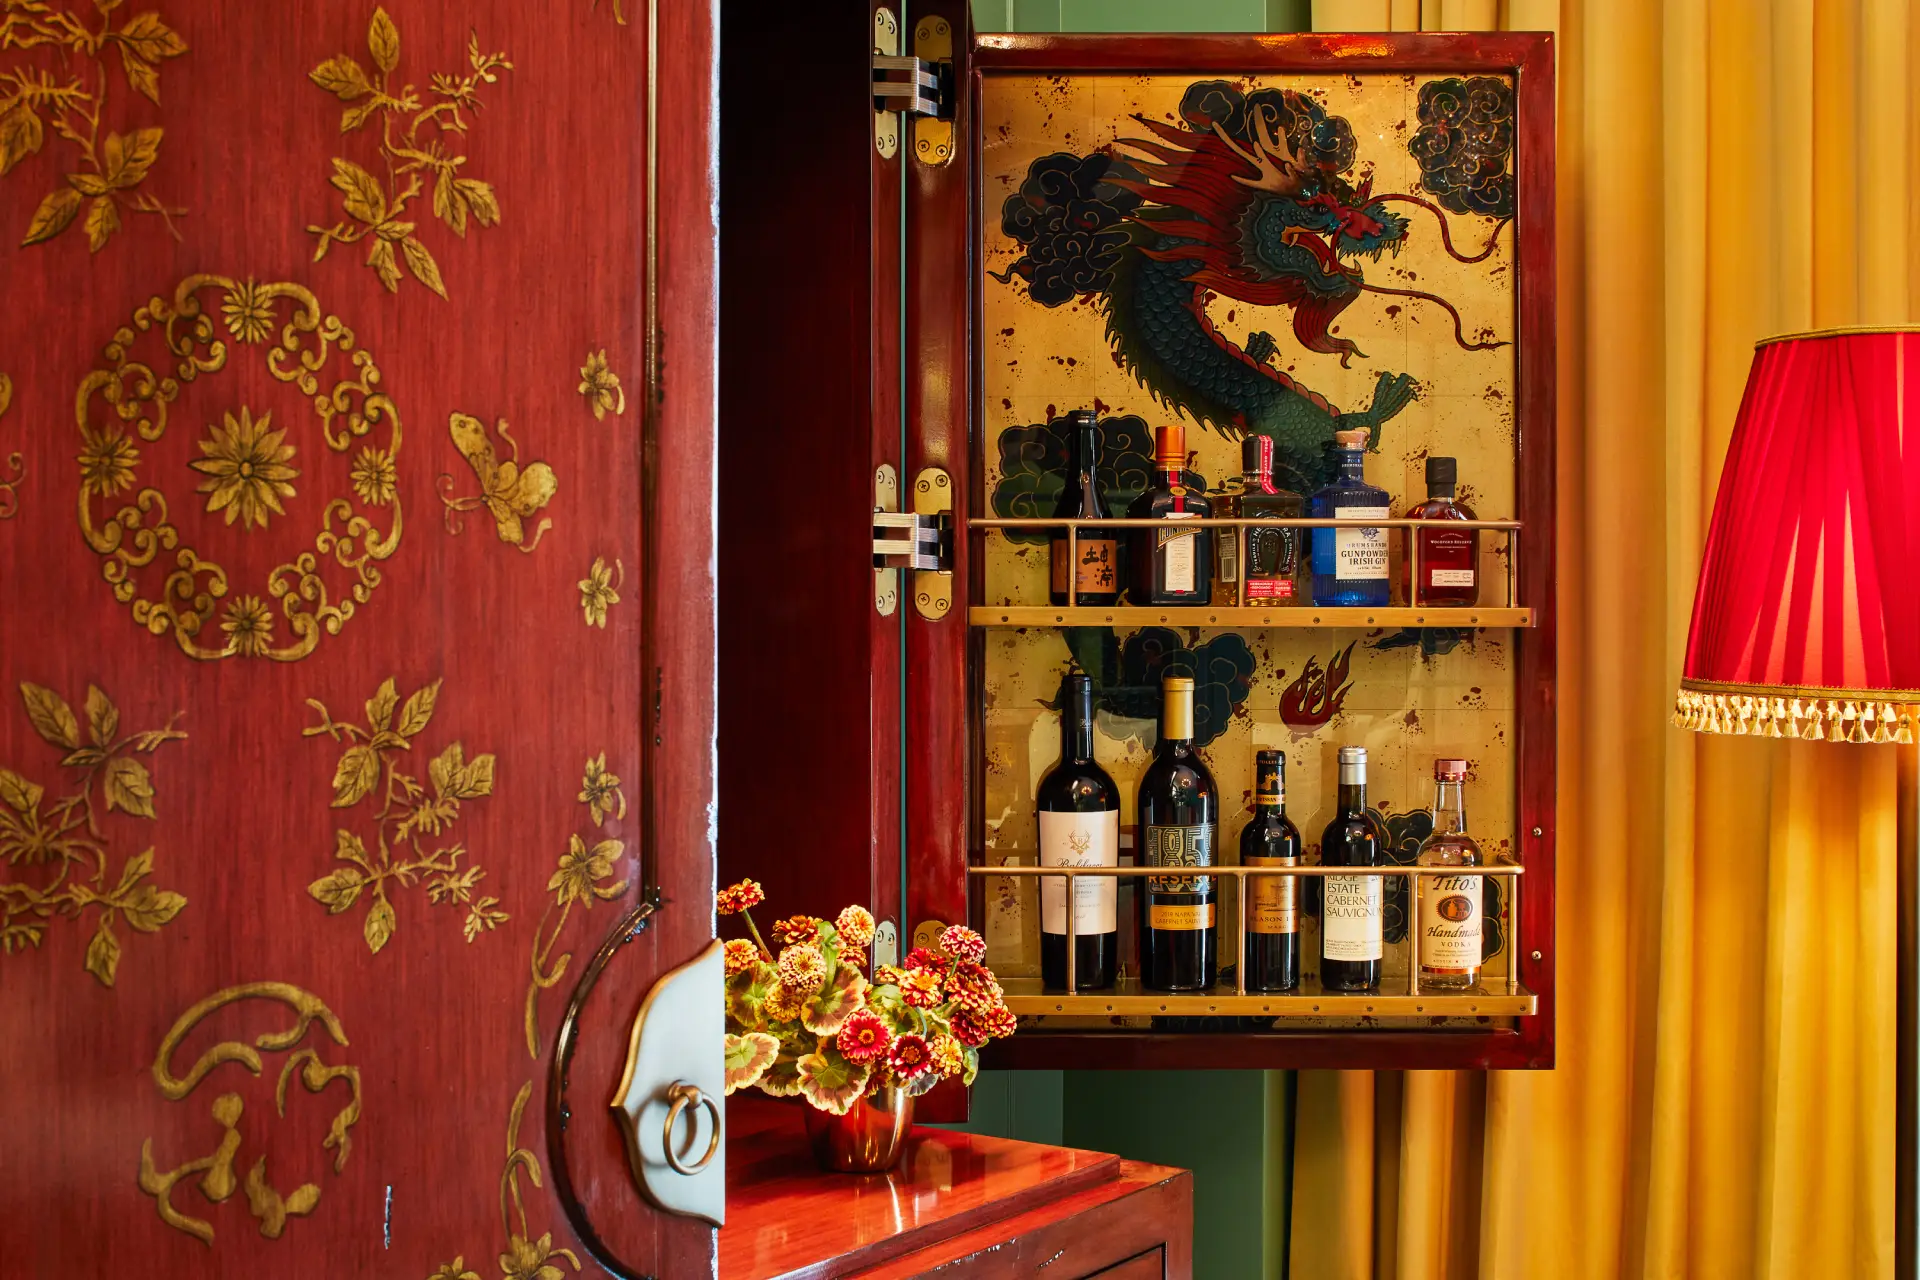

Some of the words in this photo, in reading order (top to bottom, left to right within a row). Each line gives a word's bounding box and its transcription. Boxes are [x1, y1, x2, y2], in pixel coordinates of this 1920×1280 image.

[1349, 557, 1373, 566] IRISH
[1375, 557, 1387, 565] GIN
[1327, 883, 1360, 894] ESTATE
[1432, 875, 1478, 891] Tito's
[1327, 894, 1377, 906] CABERNET
